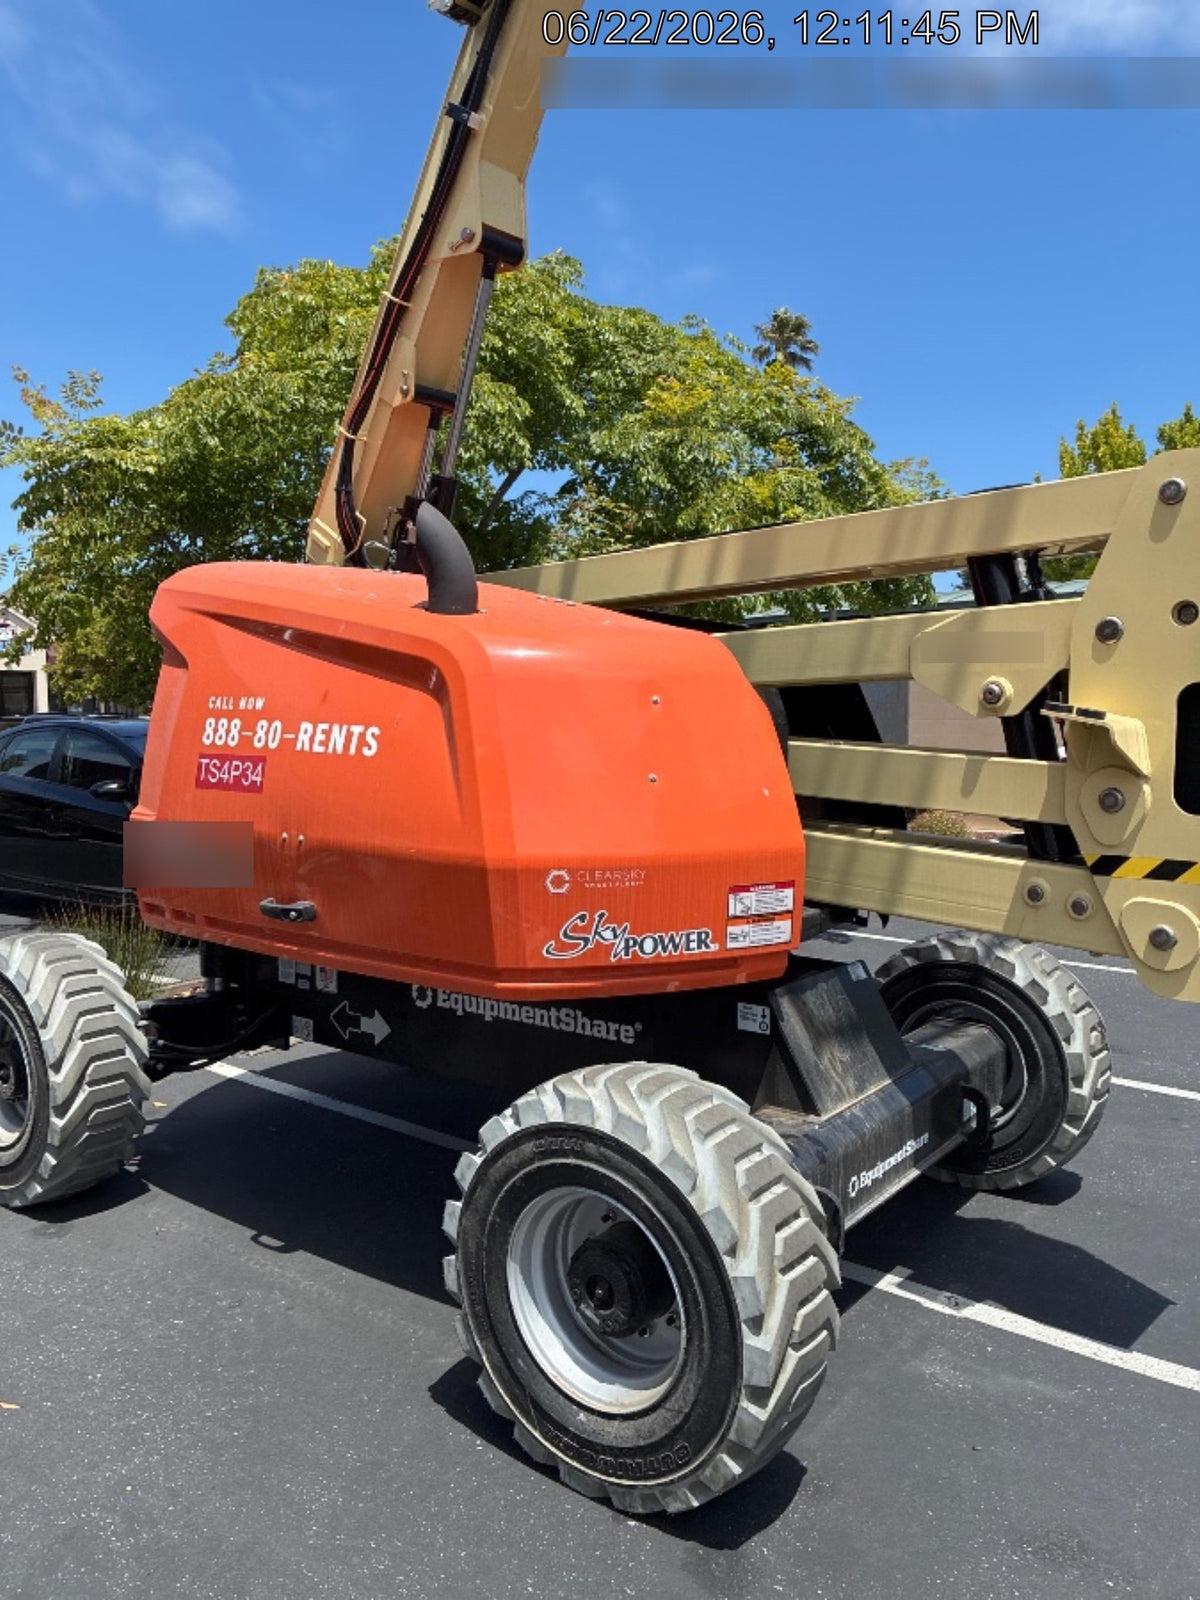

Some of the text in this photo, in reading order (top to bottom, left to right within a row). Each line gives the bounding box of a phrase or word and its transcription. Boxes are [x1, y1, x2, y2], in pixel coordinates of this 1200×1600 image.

[208, 696, 266, 711] CALL NOW
[202, 717, 381, 757] 888-80-RENTS
[199, 758, 264, 787] TS4P34
